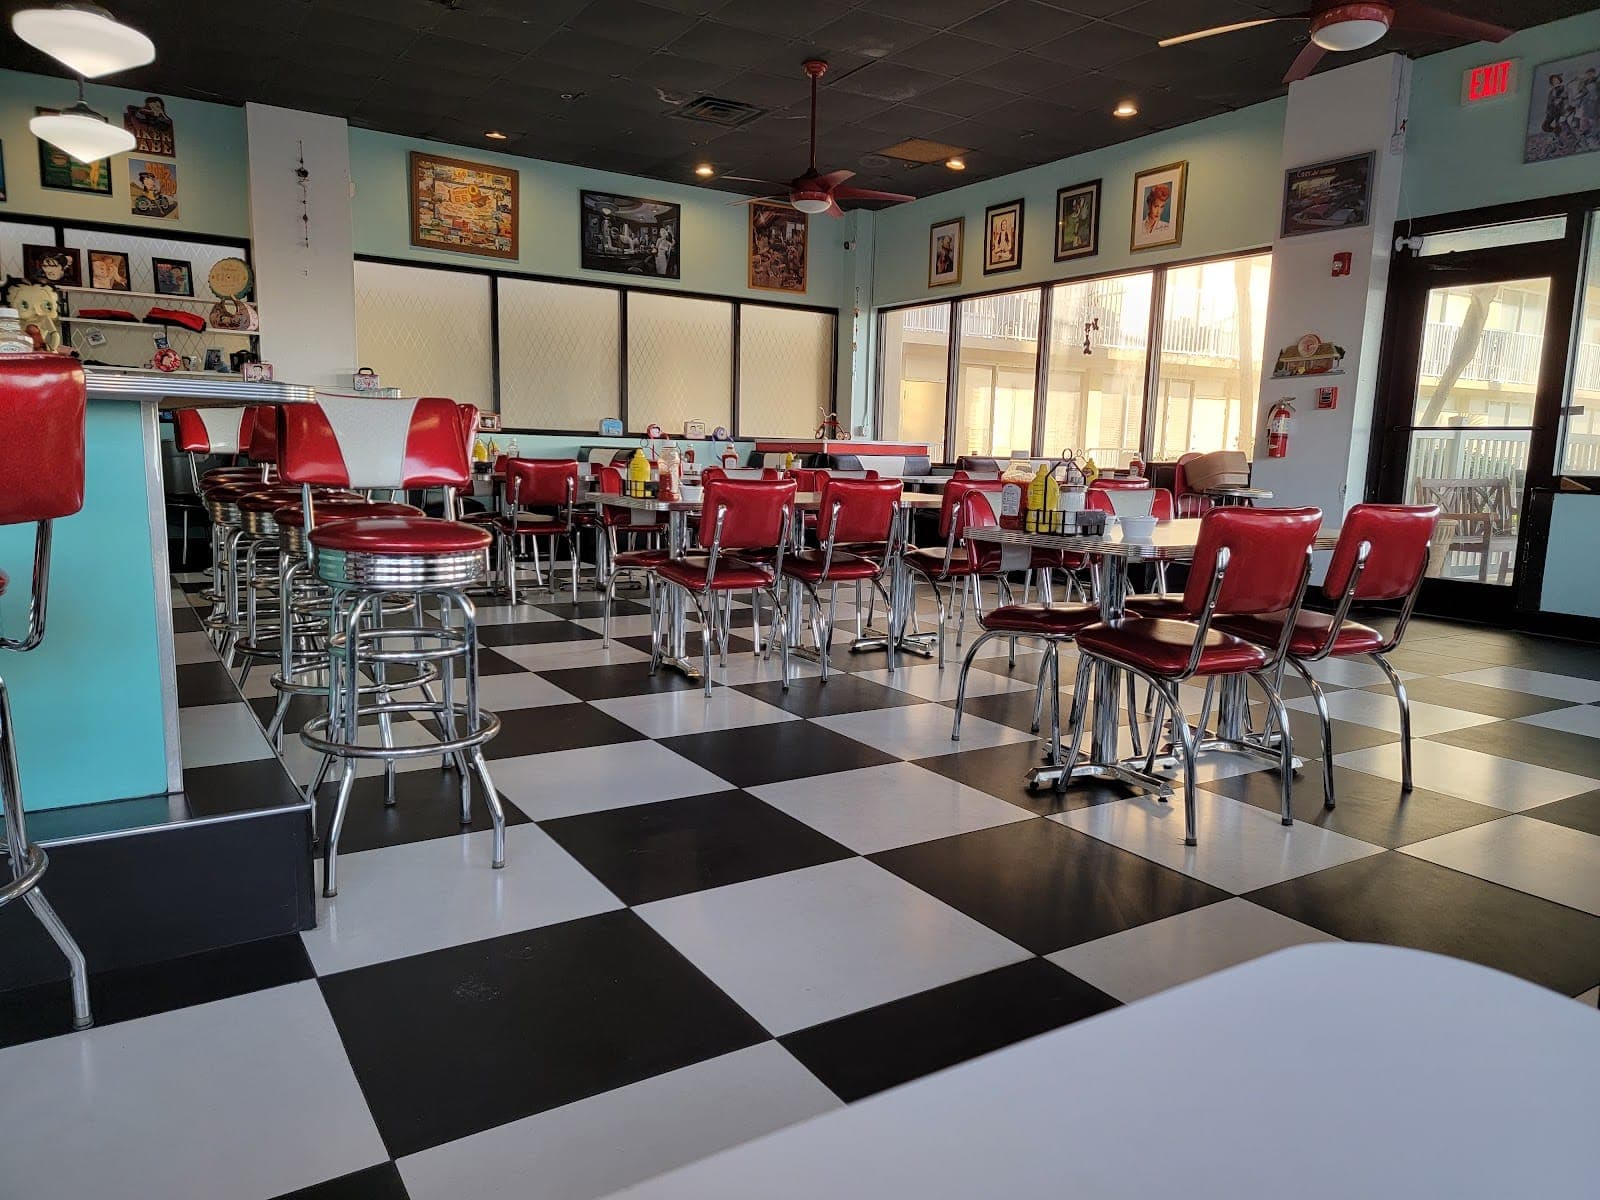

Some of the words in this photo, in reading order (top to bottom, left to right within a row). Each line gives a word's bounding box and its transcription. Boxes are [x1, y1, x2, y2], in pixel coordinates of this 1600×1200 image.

[1469, 60, 1513, 101] EXIT
[136, 127, 172, 143] IKER
[138, 139, 173, 155] ABE
